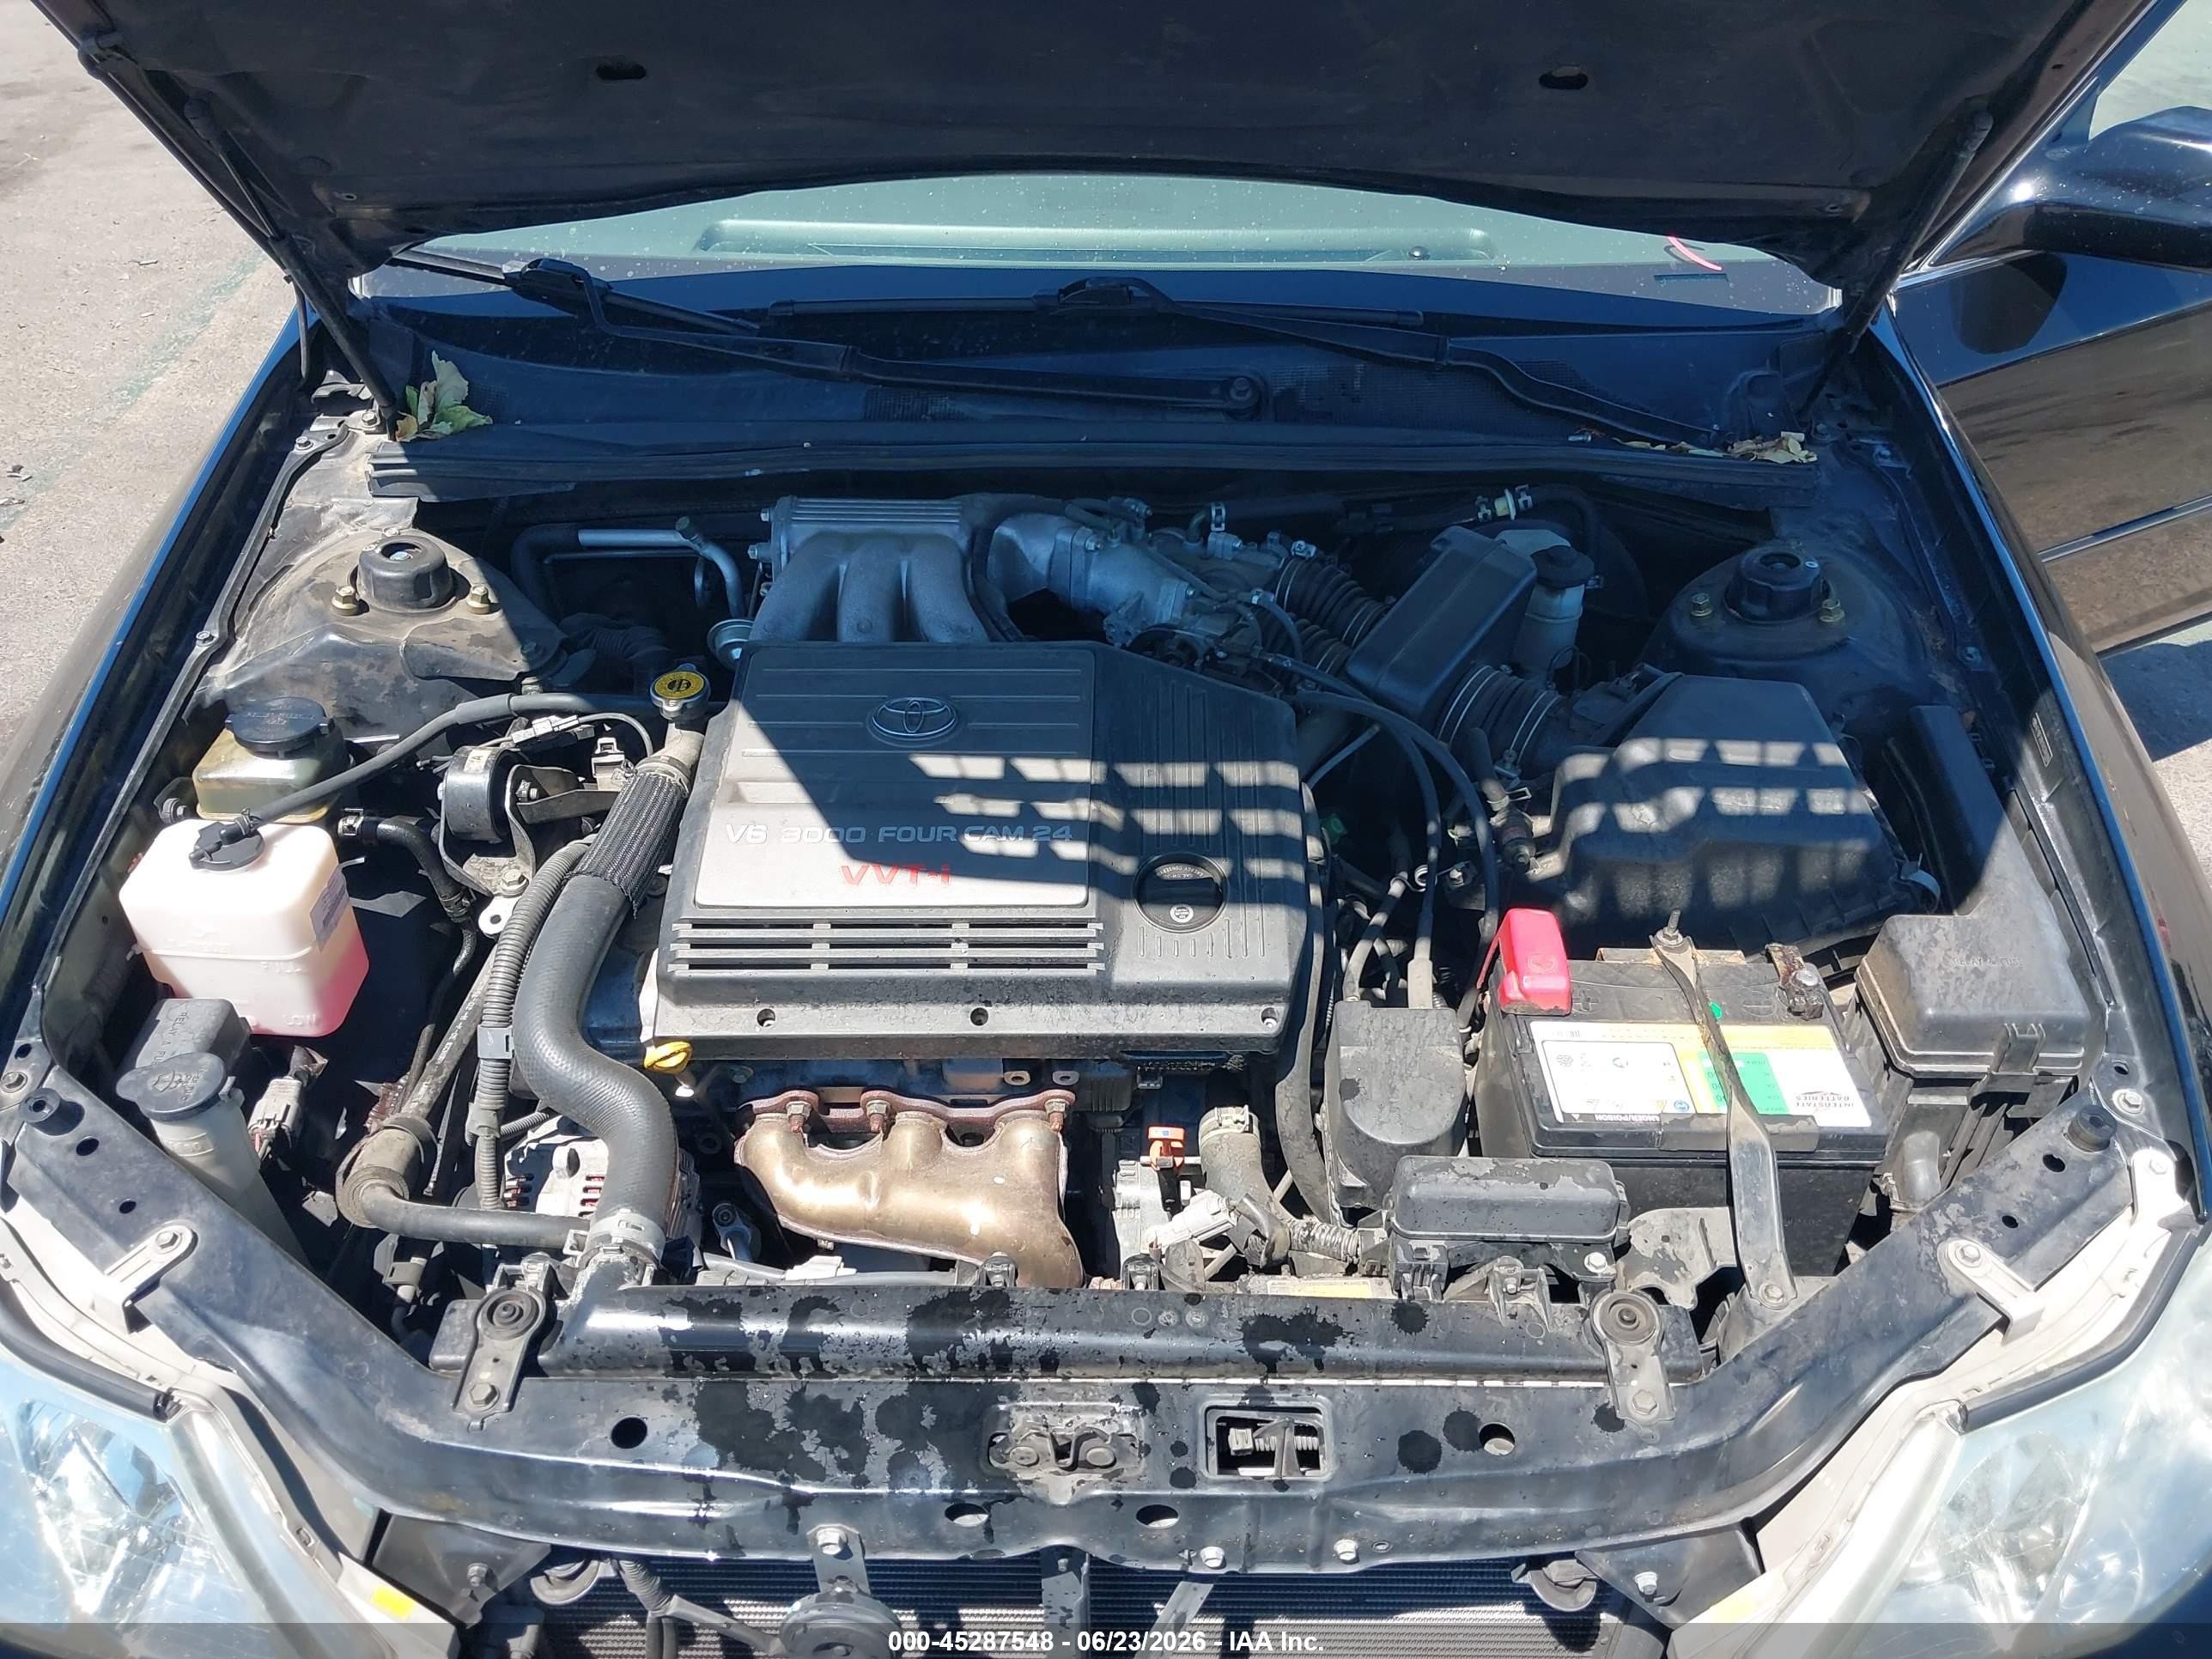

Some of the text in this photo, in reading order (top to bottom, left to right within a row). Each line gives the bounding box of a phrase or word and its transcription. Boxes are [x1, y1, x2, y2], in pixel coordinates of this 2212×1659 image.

[725, 823, 1073, 844] V6 3000 FOUR CAM 24
[168, 1012, 188, 1036] RELAY
